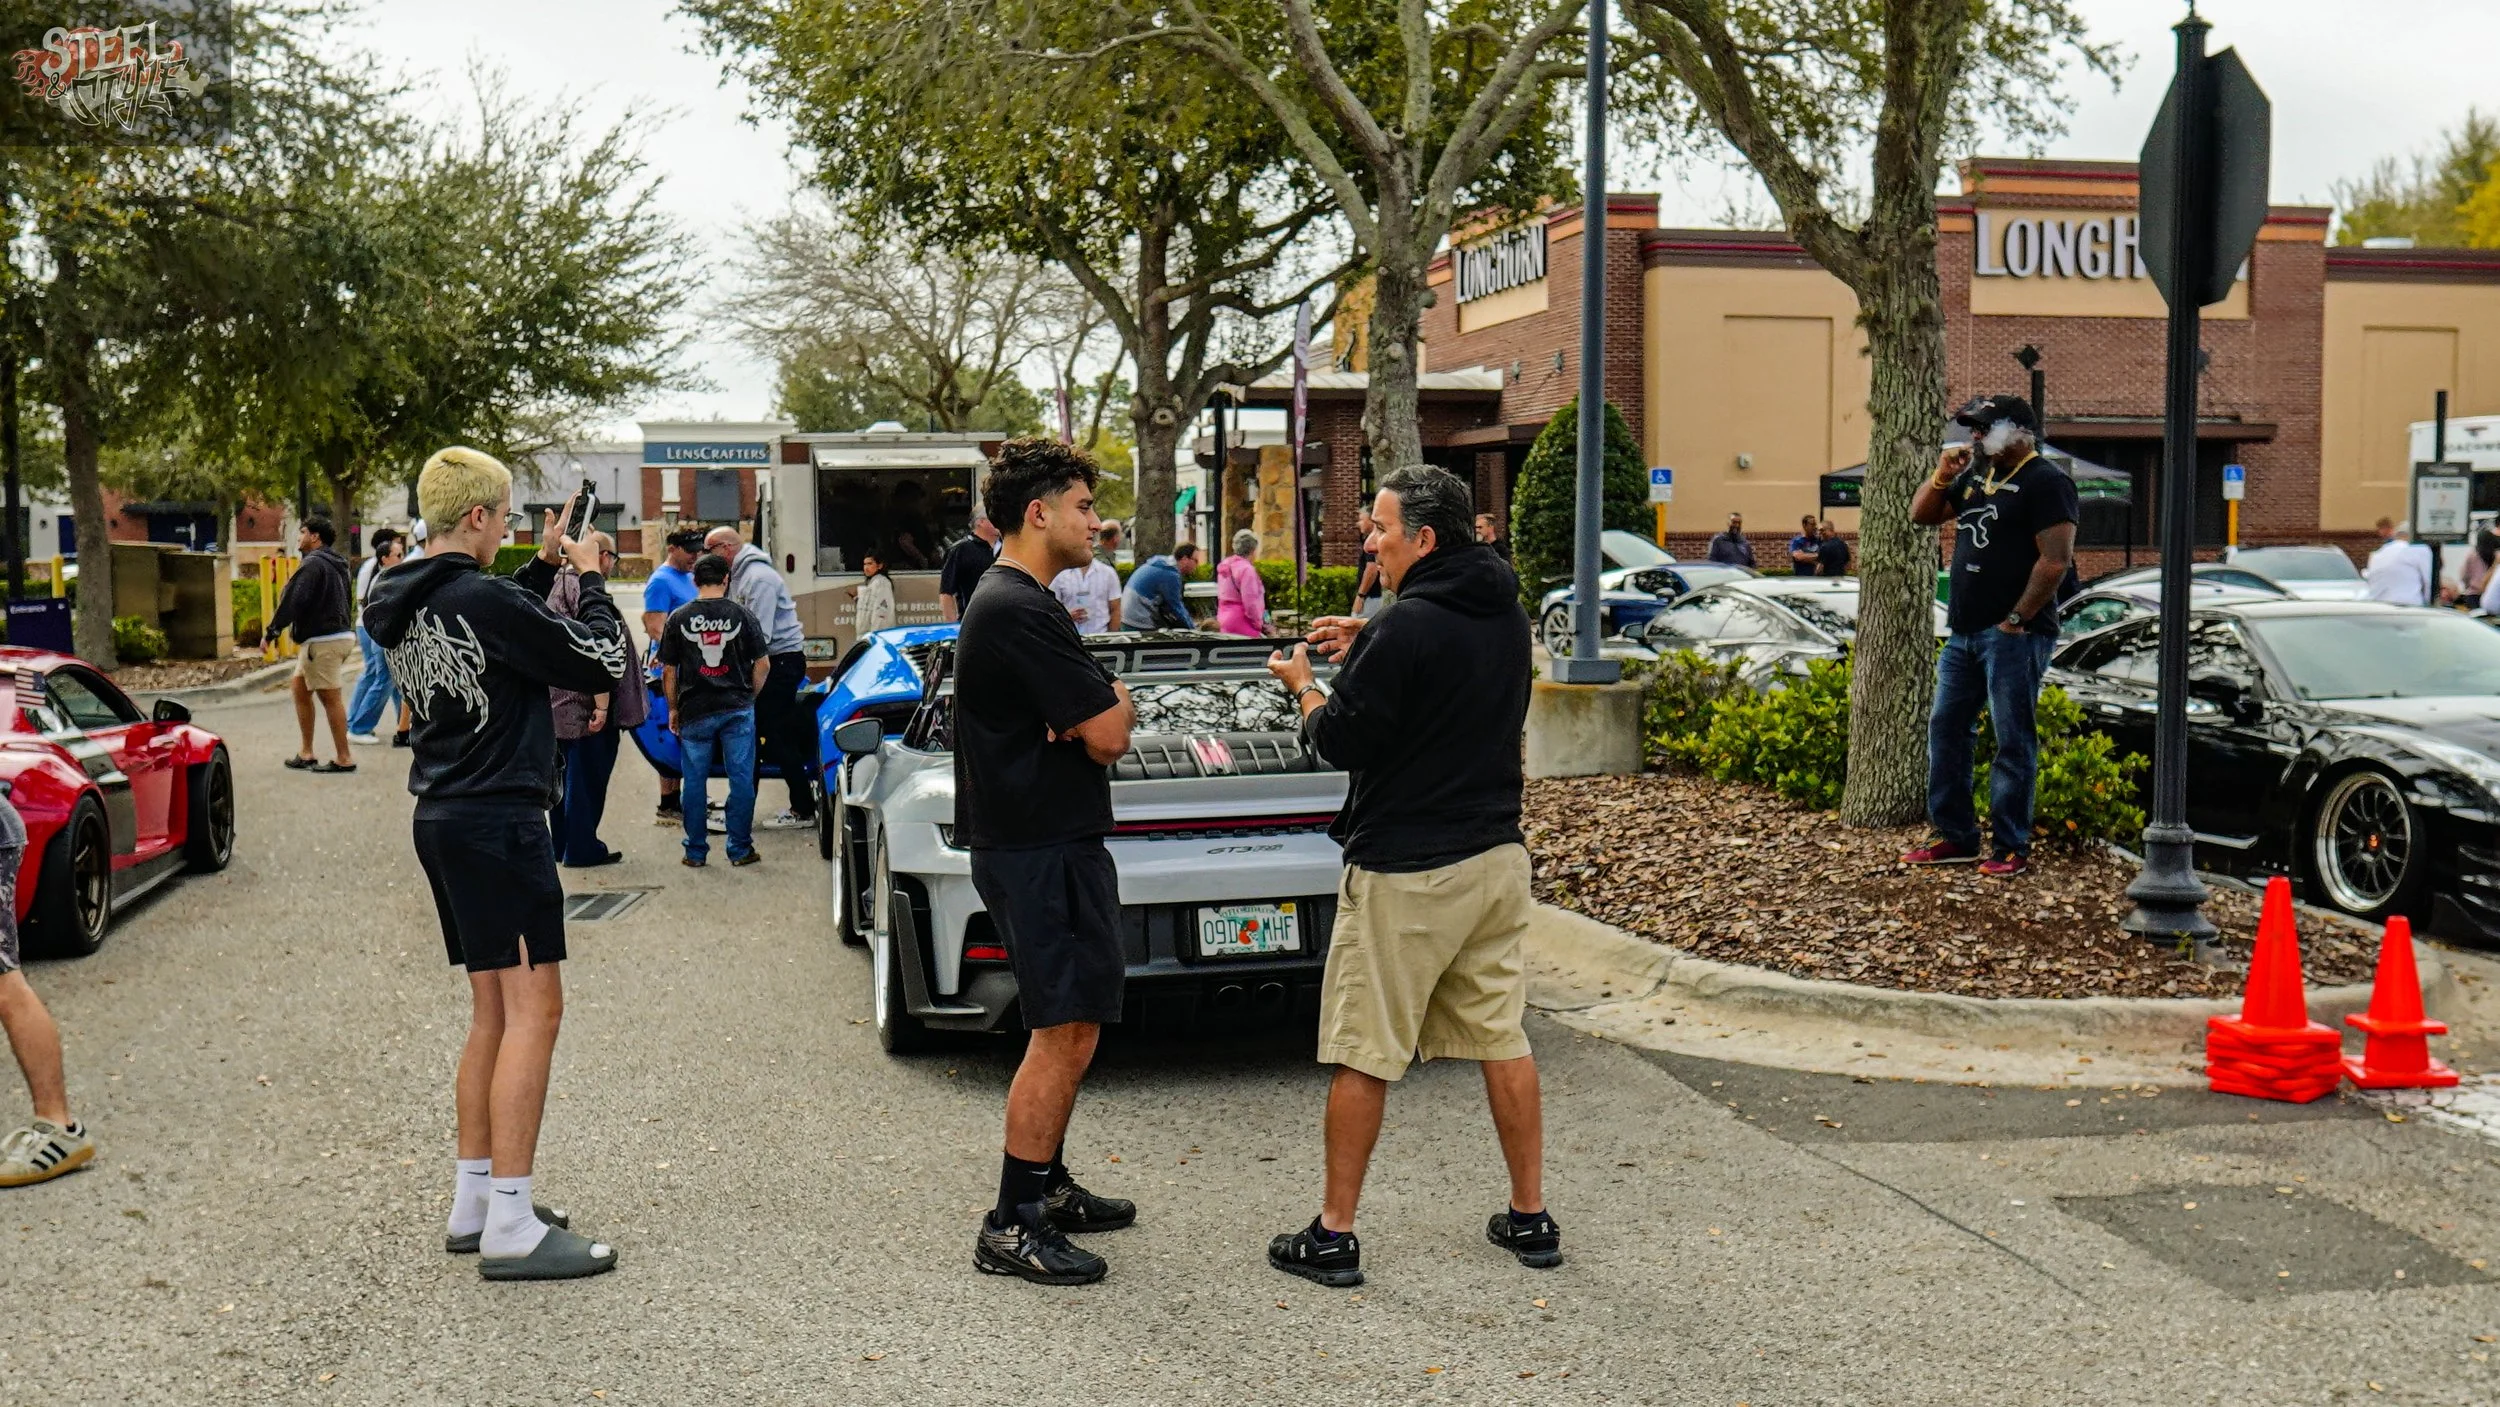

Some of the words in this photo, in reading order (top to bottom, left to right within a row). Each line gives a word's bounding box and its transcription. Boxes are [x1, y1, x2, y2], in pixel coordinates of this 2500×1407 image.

[1454, 223, 1545, 304] LONGHORN
[1976, 212, 2248, 281] LONGH
[690, 614, 732, 632] Coors
[1262, 915, 1294, 943] MHF
